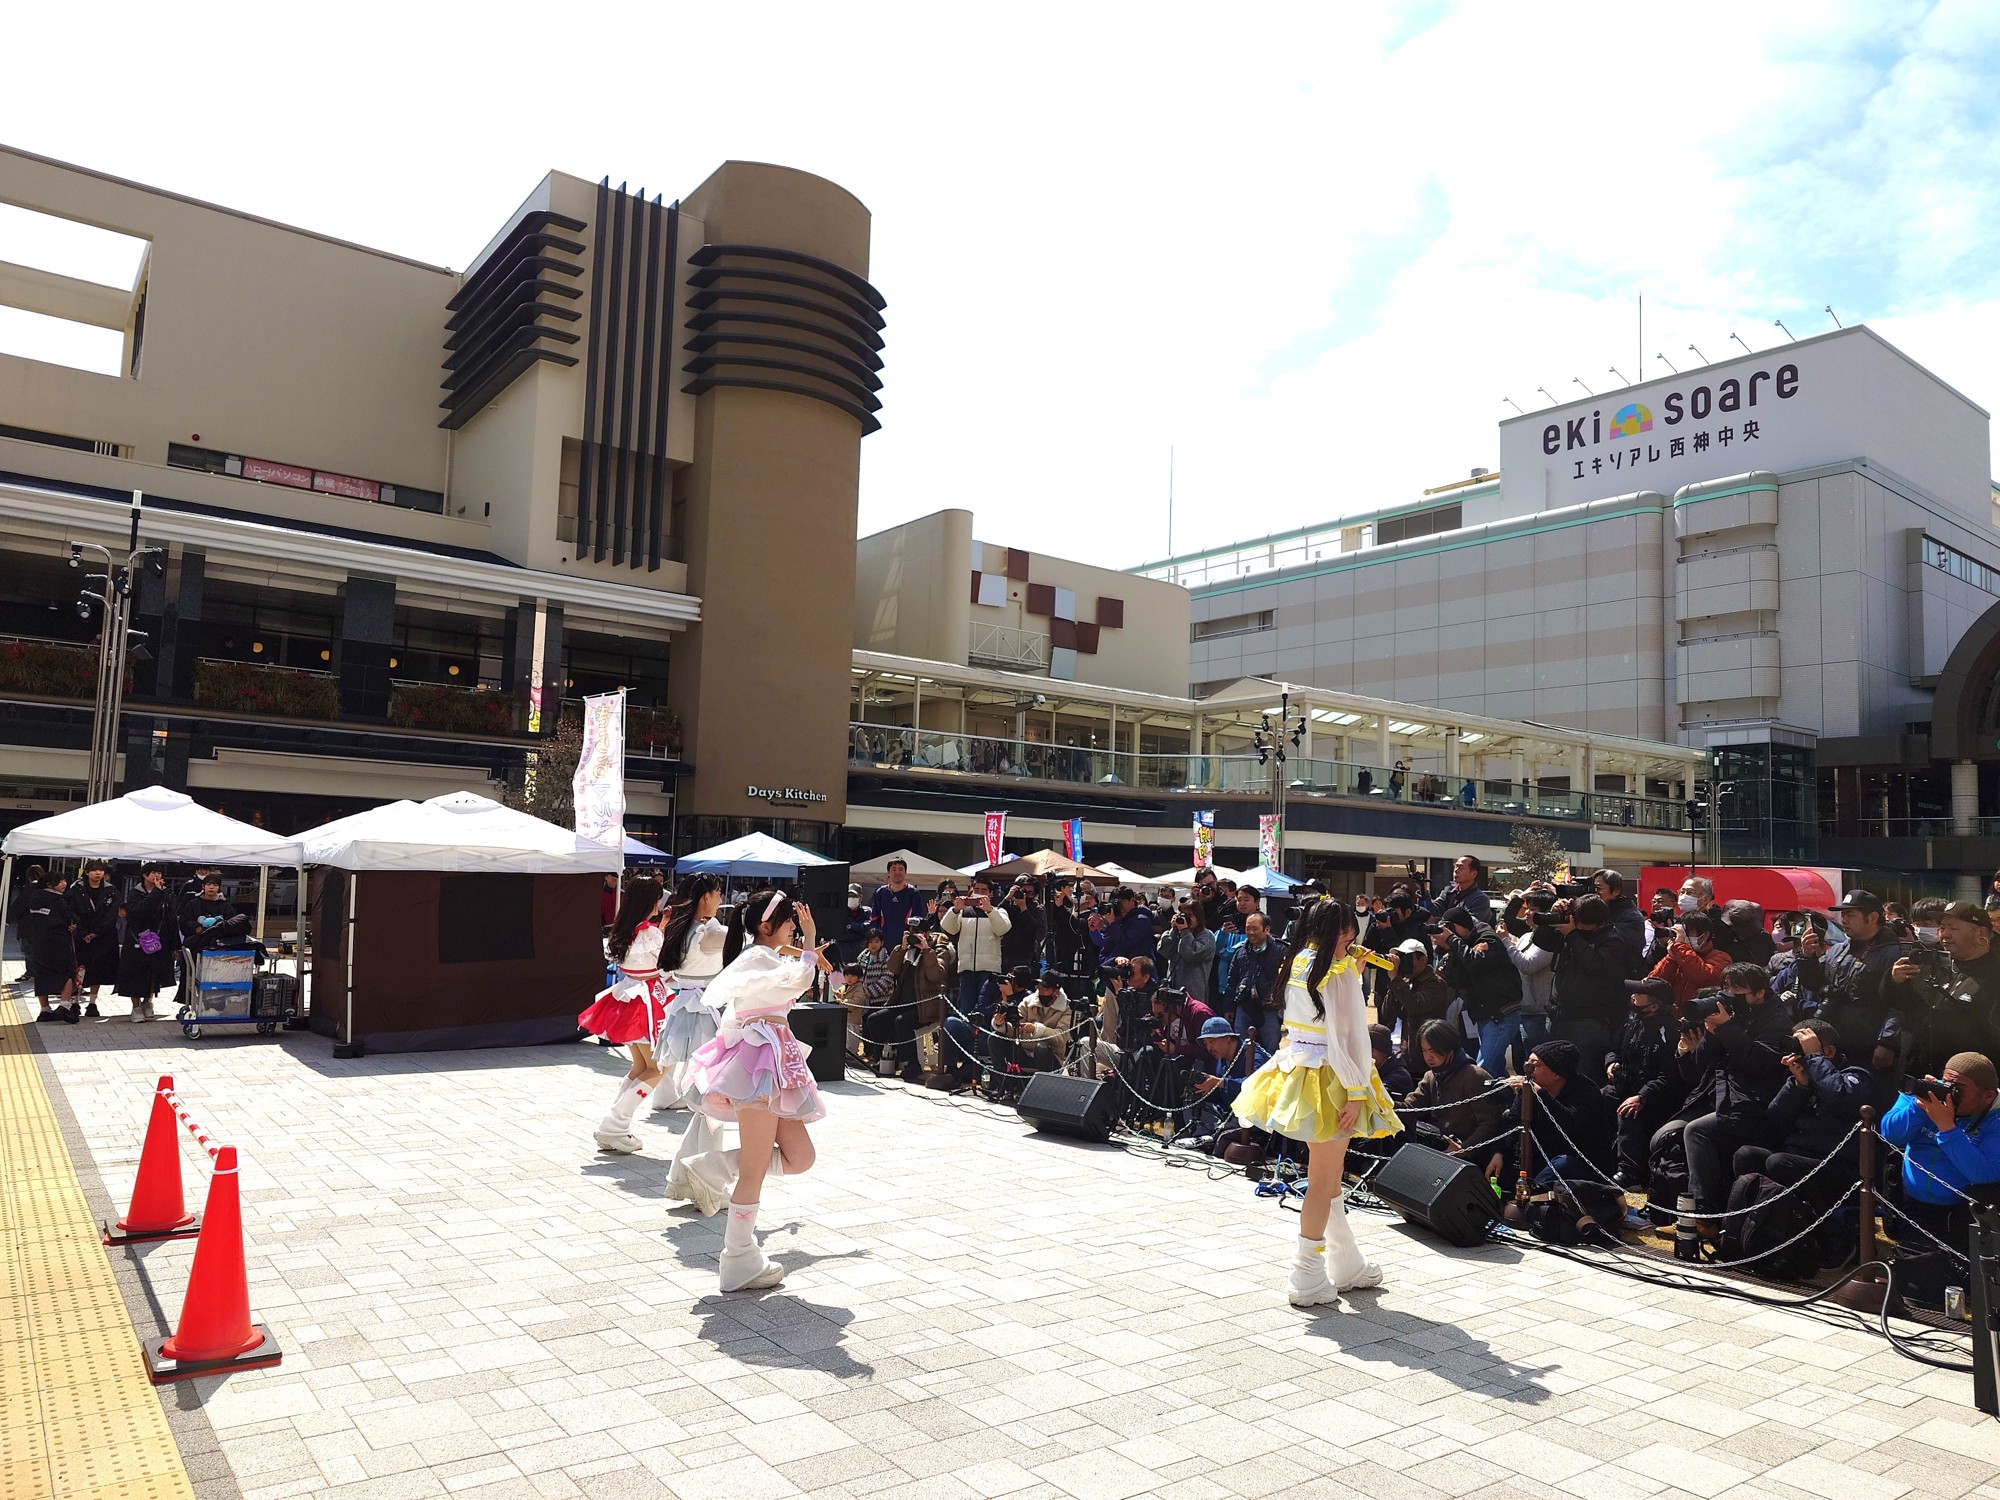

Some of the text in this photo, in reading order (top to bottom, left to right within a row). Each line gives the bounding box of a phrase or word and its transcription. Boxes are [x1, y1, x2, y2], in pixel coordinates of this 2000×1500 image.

[1543, 363, 1799, 456] eki soare
[1573, 419, 1760, 480] エキソアレ西神中央
[747, 785, 828, 802] Days Kitchen
